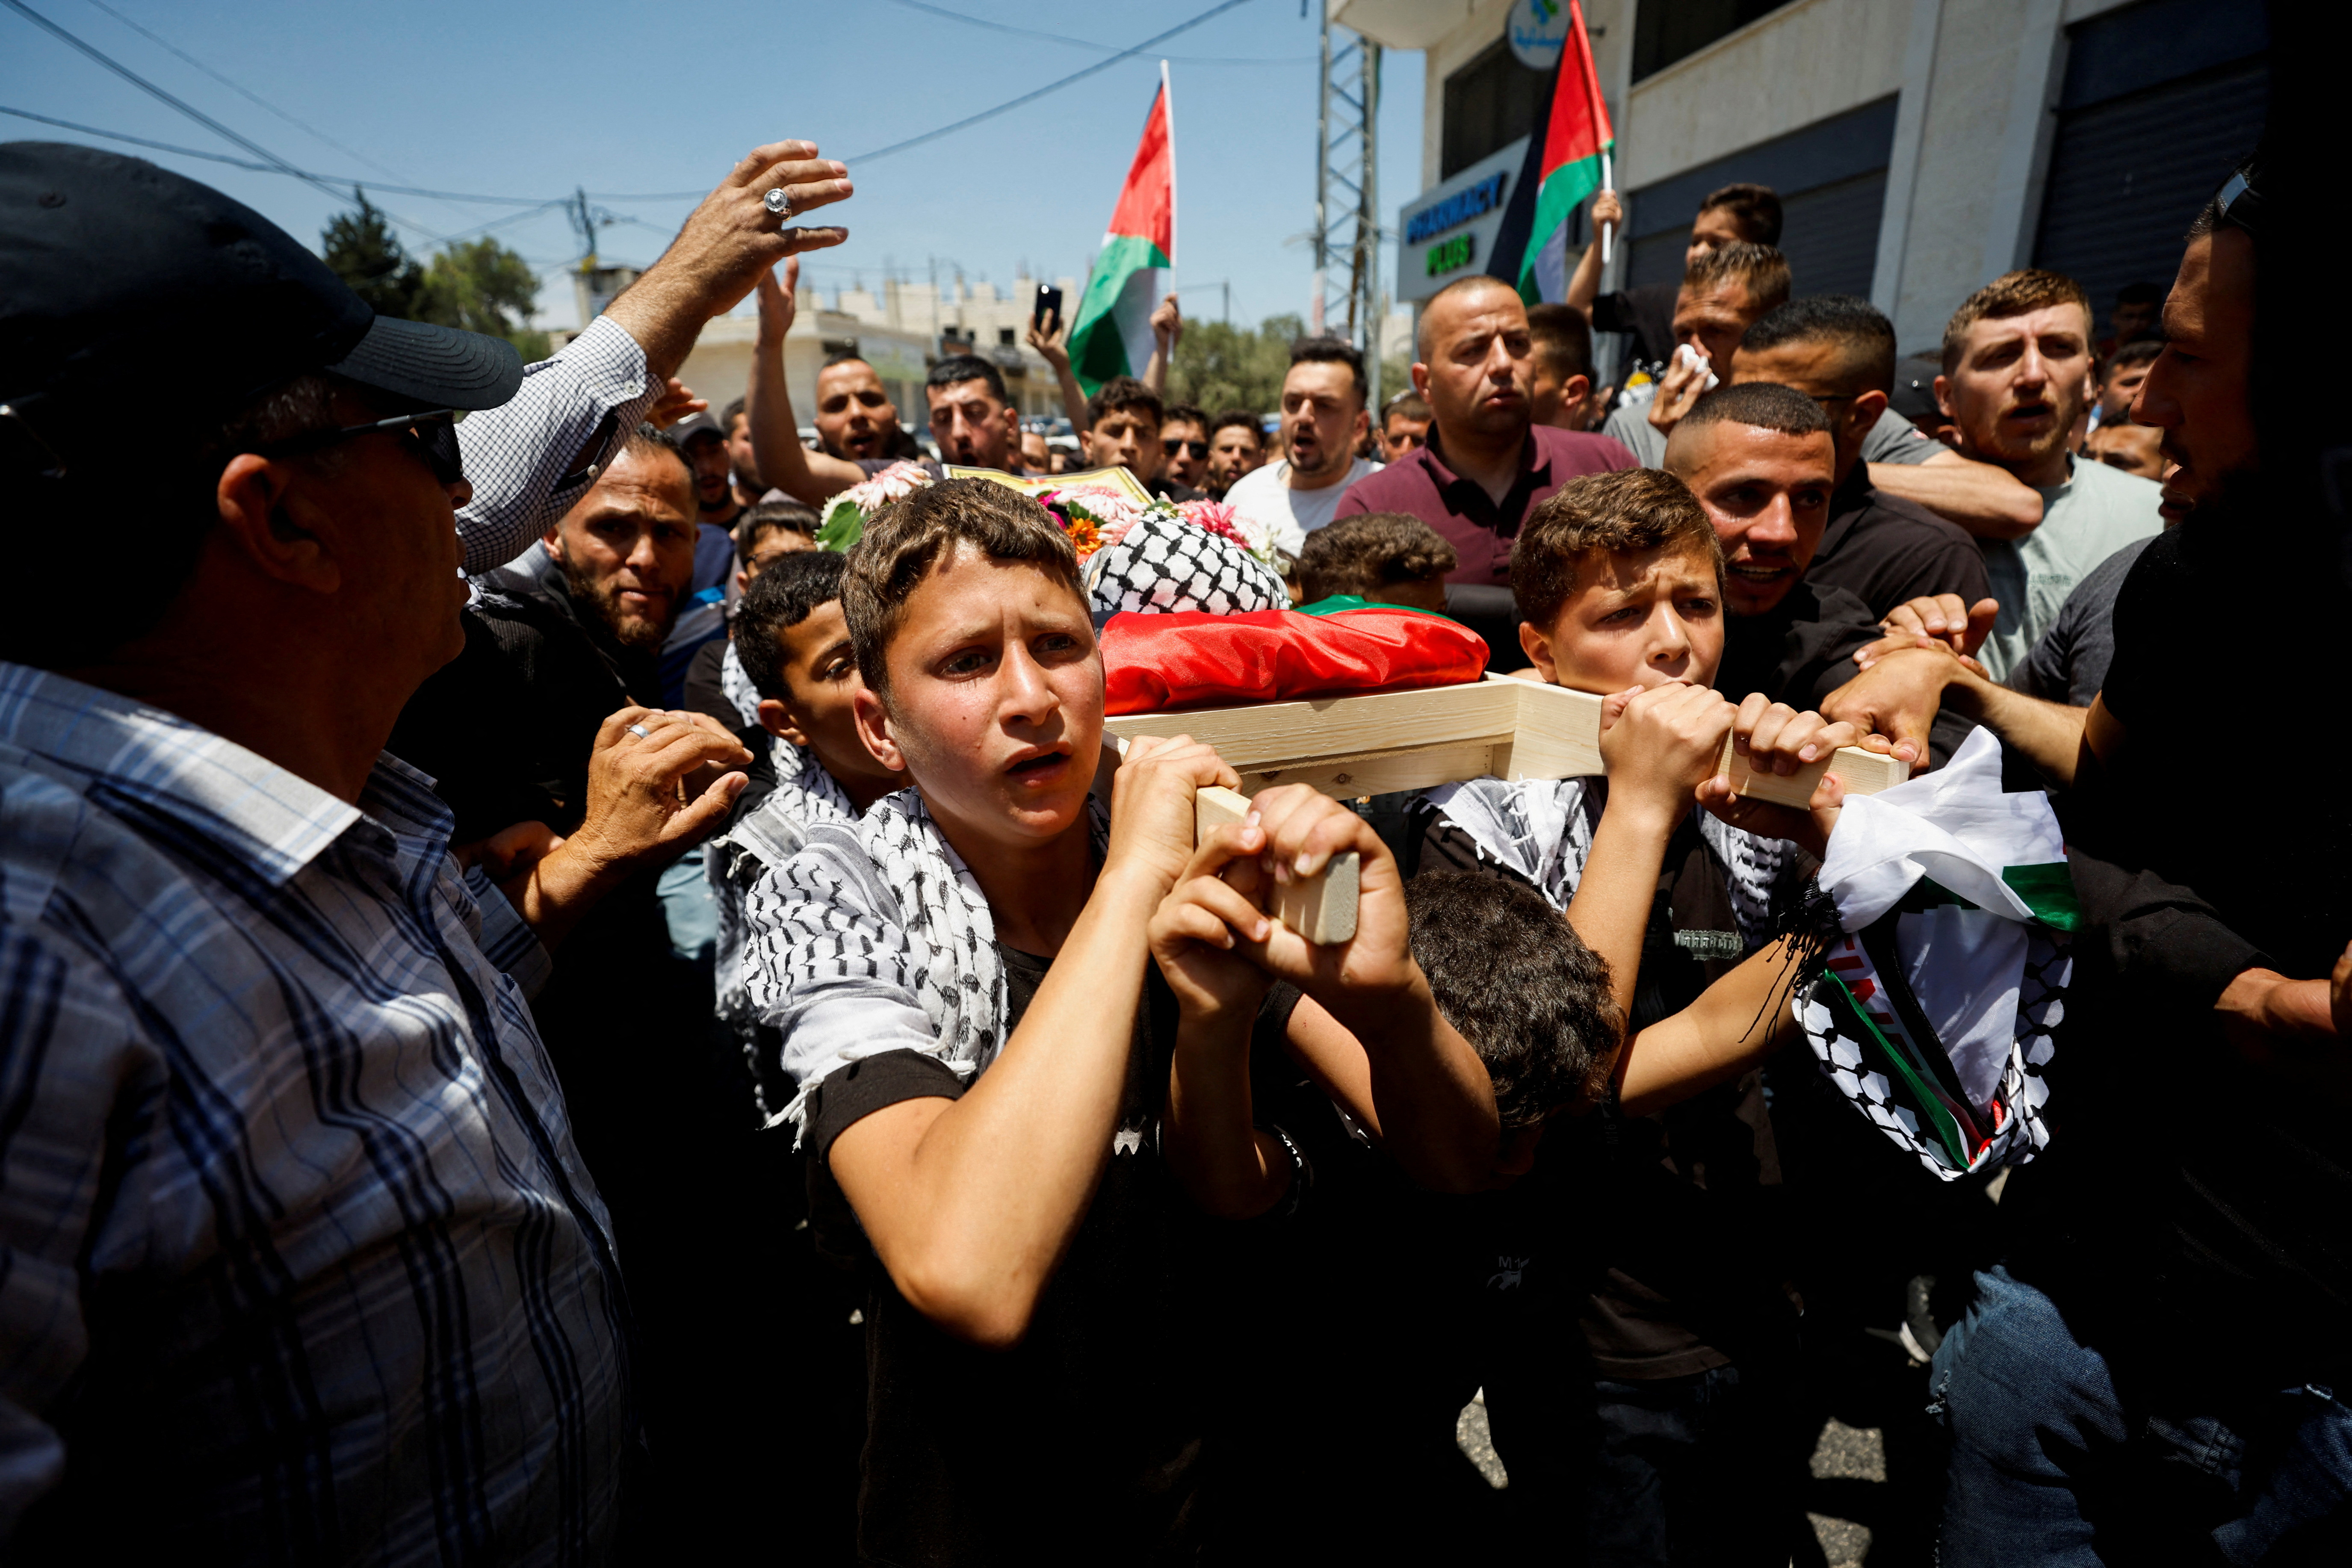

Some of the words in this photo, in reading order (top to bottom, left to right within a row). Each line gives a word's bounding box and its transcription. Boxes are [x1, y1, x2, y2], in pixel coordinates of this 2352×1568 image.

[1406, 171, 1504, 245] PHARMACY
[1426, 233, 1471, 277] PLUS
[1282, 1134, 1302, 1168] M16
[1498, 1255, 1521, 1269] M1
